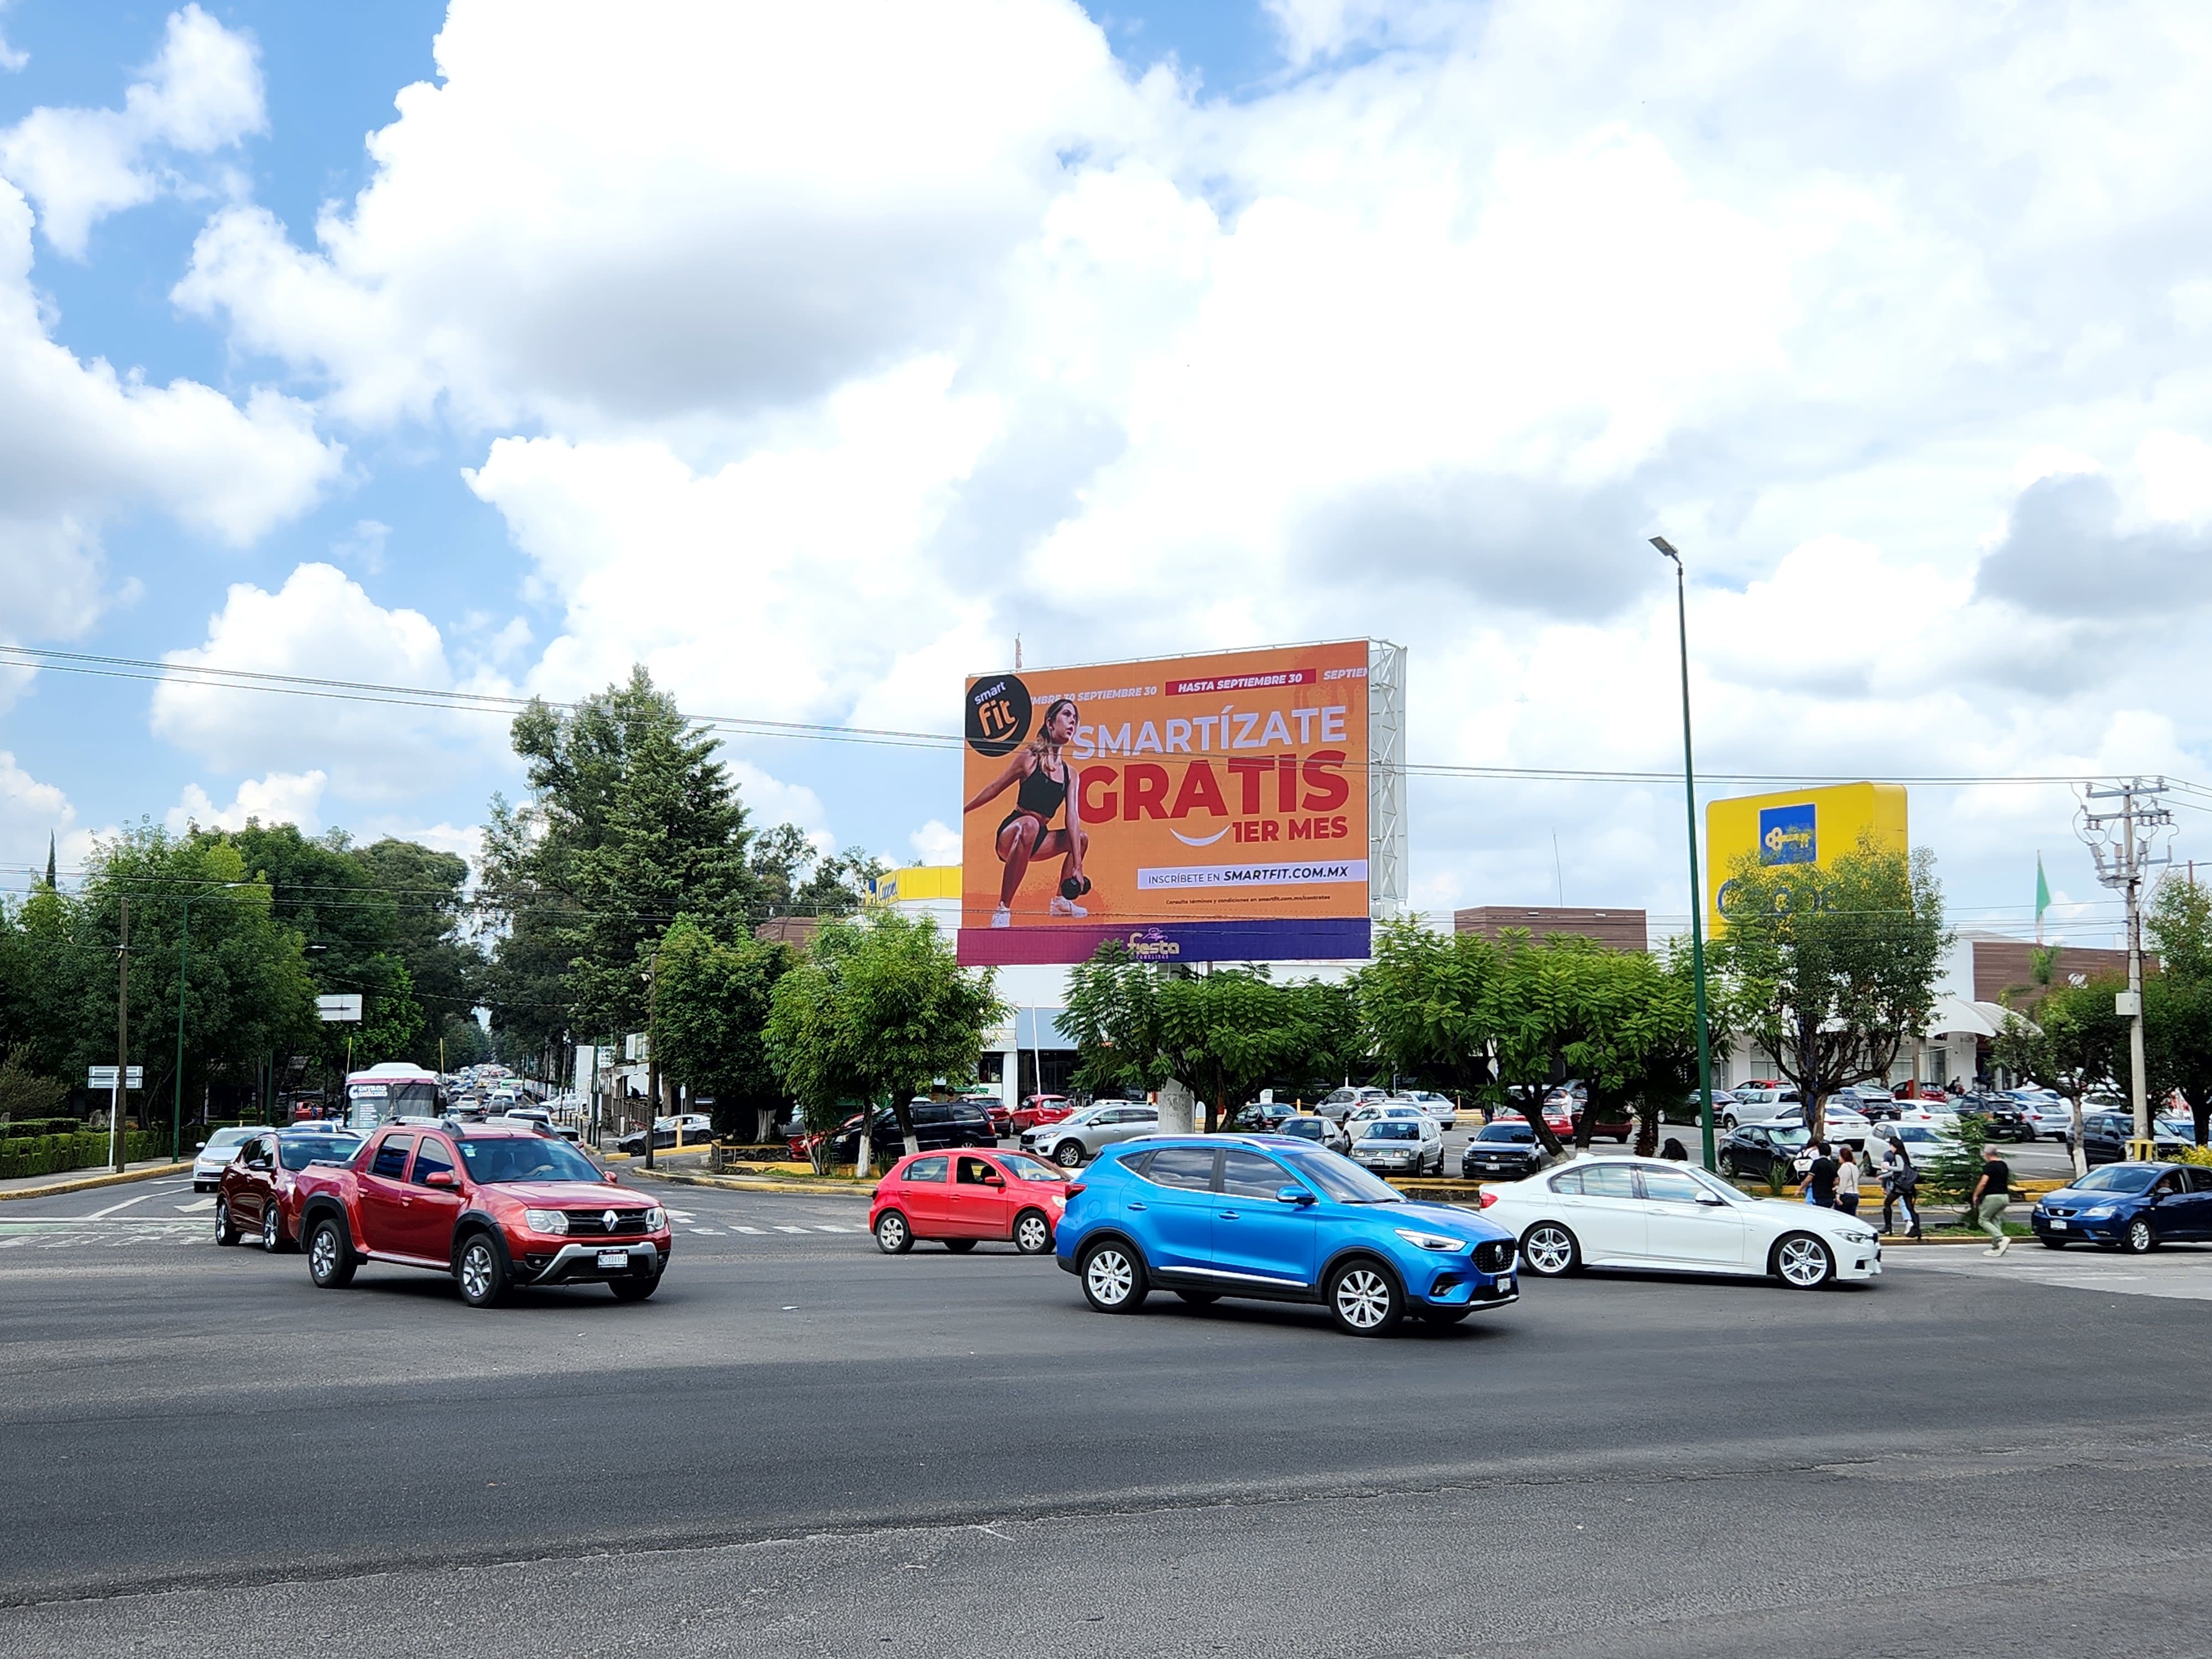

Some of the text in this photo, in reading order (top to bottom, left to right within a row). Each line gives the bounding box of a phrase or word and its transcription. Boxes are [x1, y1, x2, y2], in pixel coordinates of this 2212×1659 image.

[974, 681, 1006, 706] smart
[1031, 694, 1061, 705] MBRE
[1077, 687, 1142, 702] SEPTIEMBRE
[1144, 686, 1157, 696] 30
[1178, 673, 1303, 693] HASTA SEPTIEMBRE 30
[978, 699, 1016, 737] fit
[1072, 705, 1347, 760] SMARTÍZATE
[1078, 749, 1349, 824] GRATIS
[1232, 816, 1348, 843] 1ER MES
[1148, 866, 1349, 885] INSCRÍBETE EN SMARTFIT.COM.MX
[1127, 932, 1180, 955] fiesta
